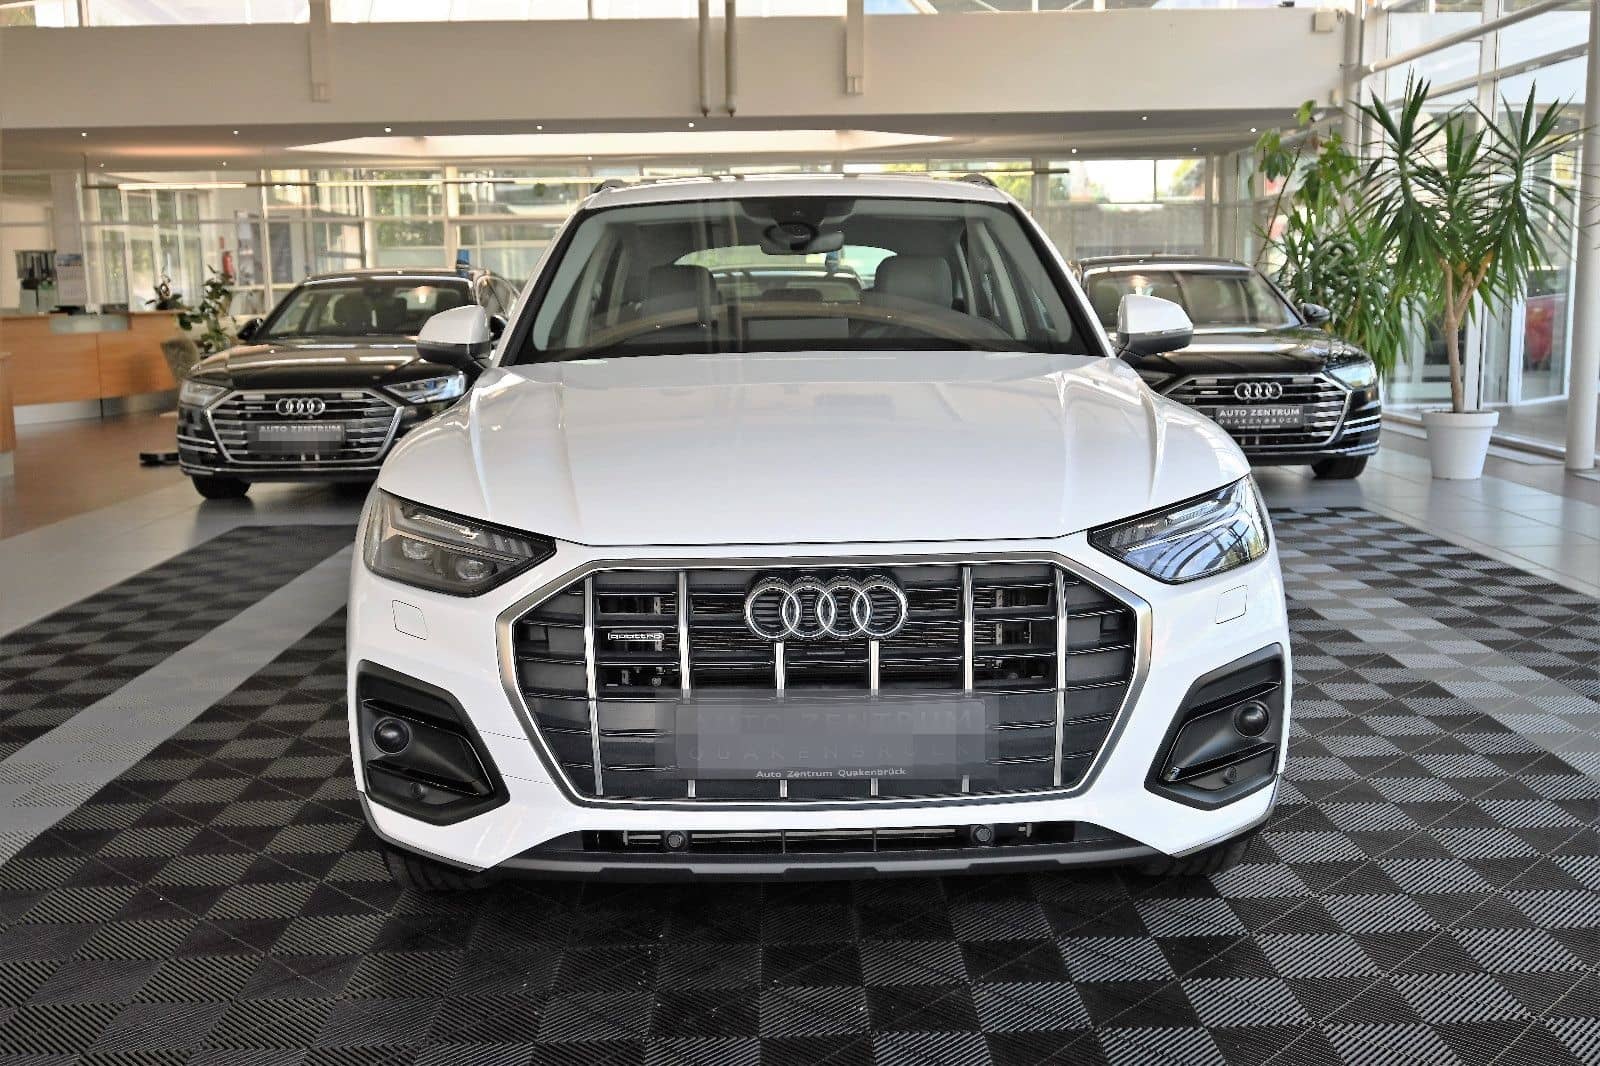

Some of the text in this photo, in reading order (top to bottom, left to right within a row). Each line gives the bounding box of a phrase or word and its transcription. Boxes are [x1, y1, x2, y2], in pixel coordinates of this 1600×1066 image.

[1219, 408, 1300, 417] AUTO ZENTRUM
[609, 632, 663, 640] quattro
[755, 767, 907, 778] Auto Zentrum Quakenbrück
